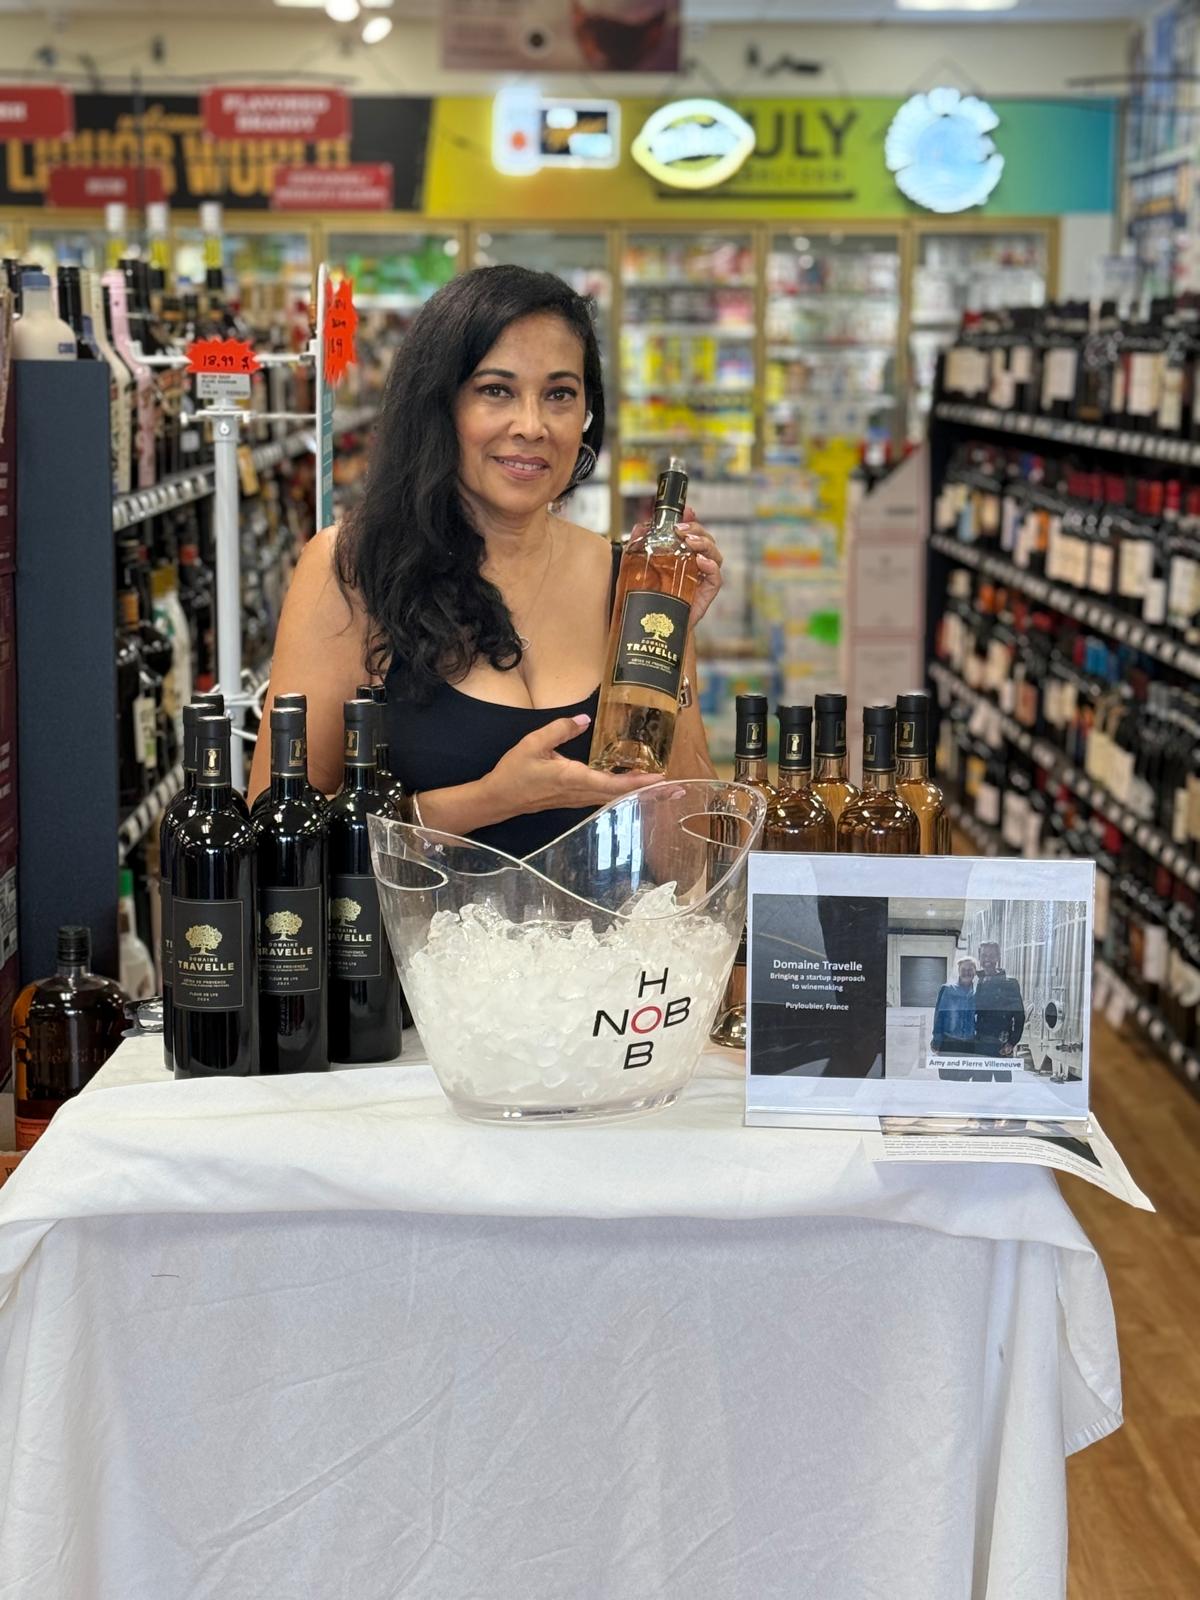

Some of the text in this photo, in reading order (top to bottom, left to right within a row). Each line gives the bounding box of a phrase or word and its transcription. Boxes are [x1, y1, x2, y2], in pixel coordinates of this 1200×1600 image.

[626, 643, 678, 662] TRAVELLE
[178, 960, 235, 972] TRAVELLE
[773, 960, 863, 971] Domaine Travelle
[770, 973, 799, 981] Bringing
[806, 974, 831, 982] startup
[832, 975, 866, 983] approach
[801, 983, 844, 992] winemaking
[785, 1002, 849, 1011] Puyloubier, France
[929, 1059, 945, 1068] Amy
[946, 1059, 960, 1067] and
[984, 1060, 1022, 1069] Villeneuve
